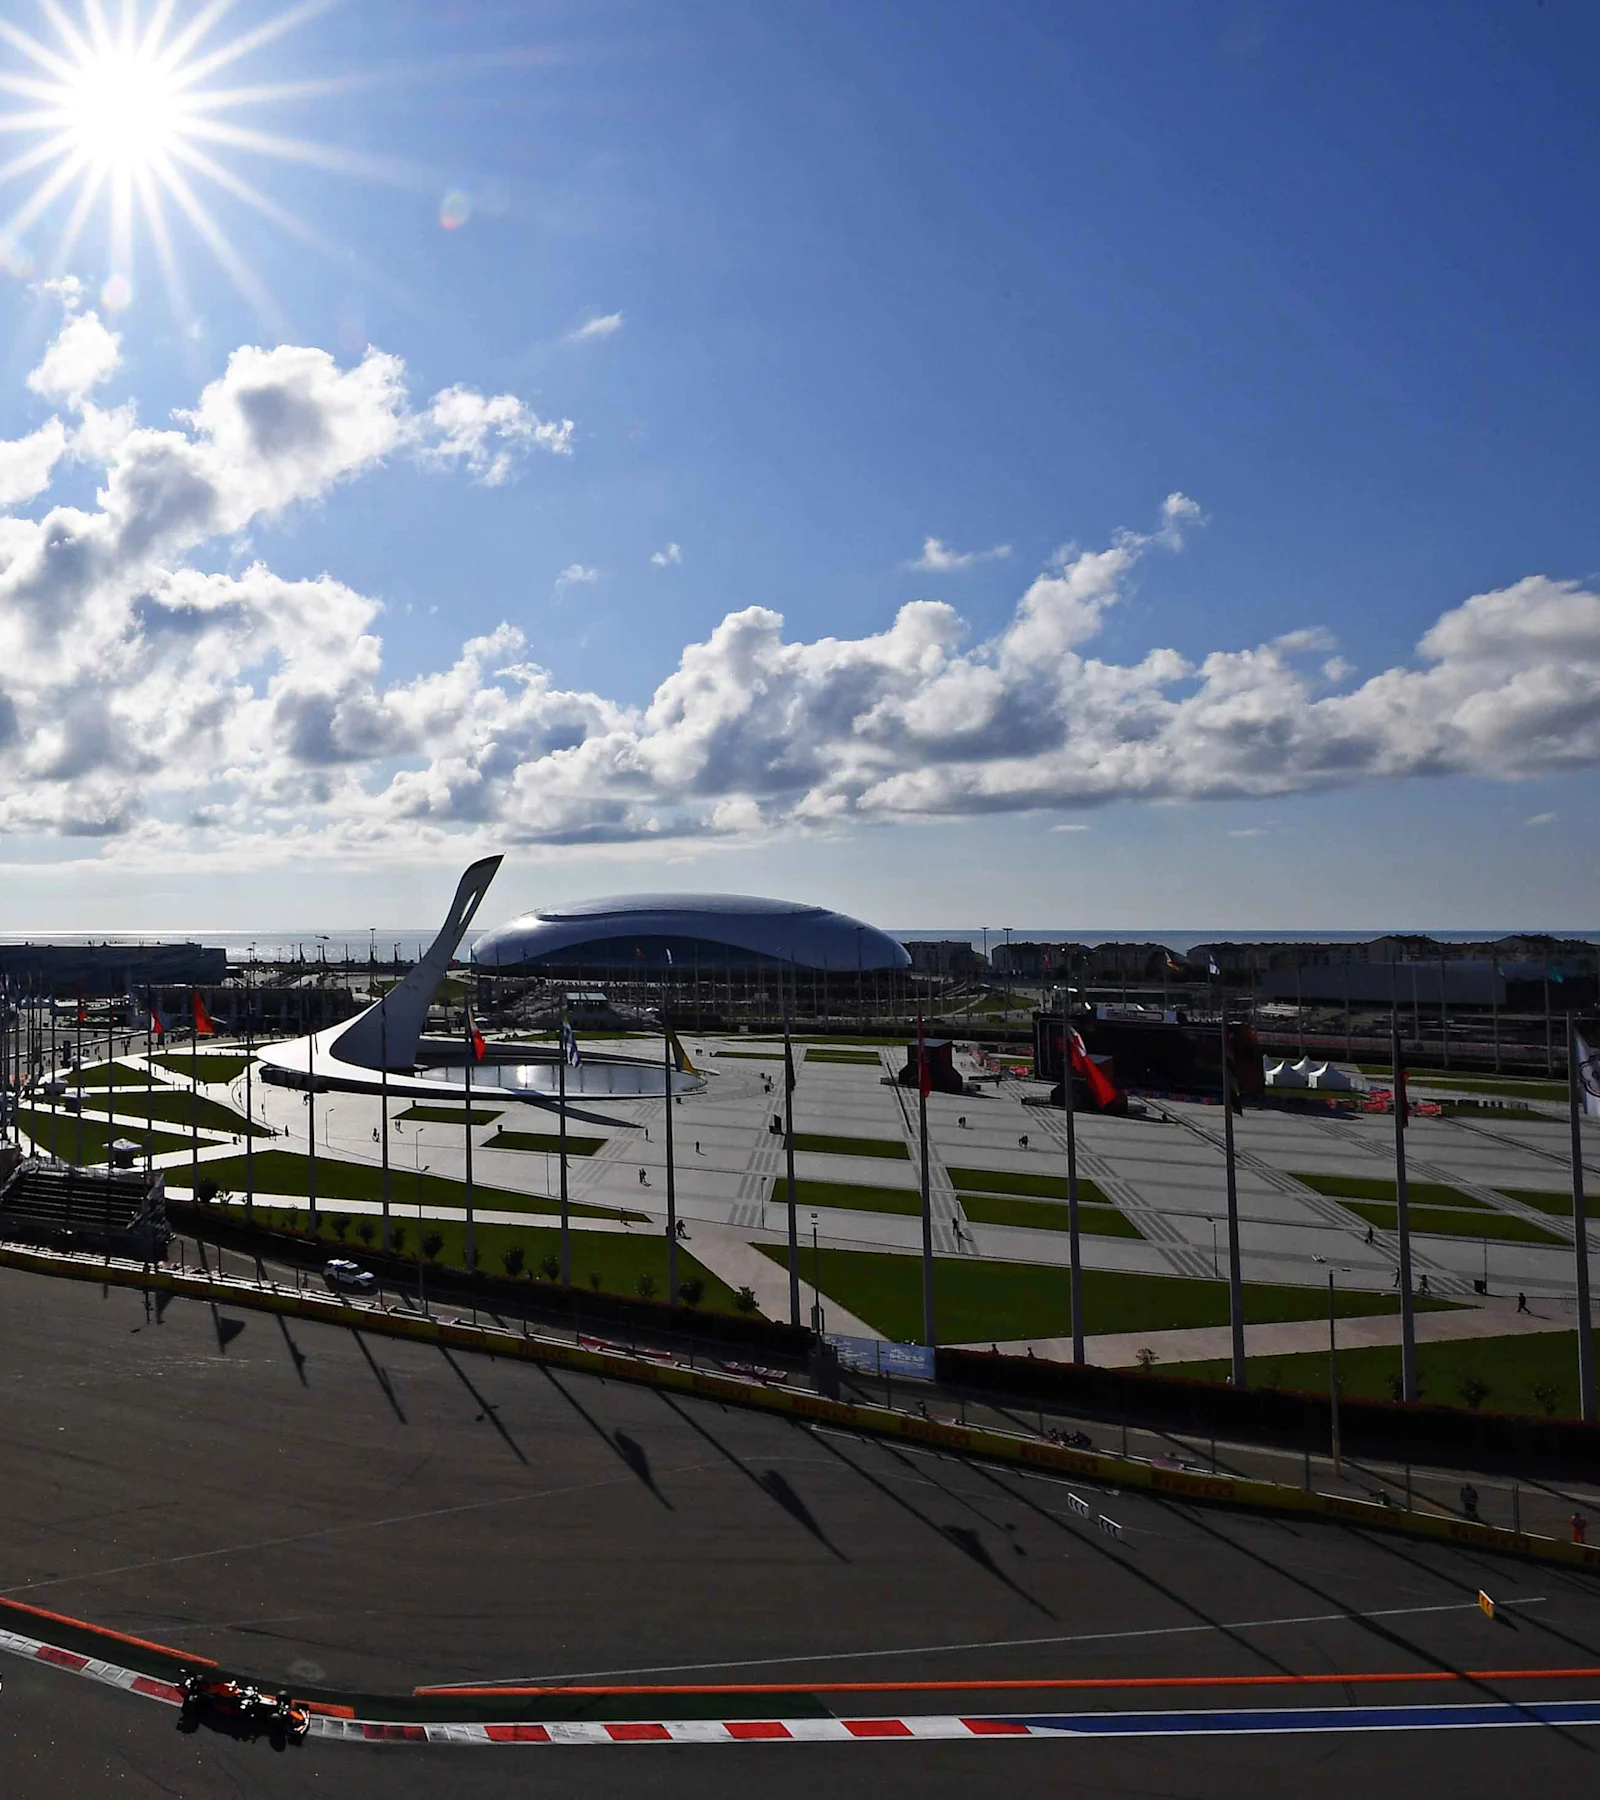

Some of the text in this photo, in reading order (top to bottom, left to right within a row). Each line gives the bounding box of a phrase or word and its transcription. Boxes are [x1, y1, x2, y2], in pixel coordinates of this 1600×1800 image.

[900, 1417, 972, 1447] PIRELLI
[1020, 1441, 1099, 1473] PIRELLI
[1150, 1466, 1236, 1496] PIRELLI
